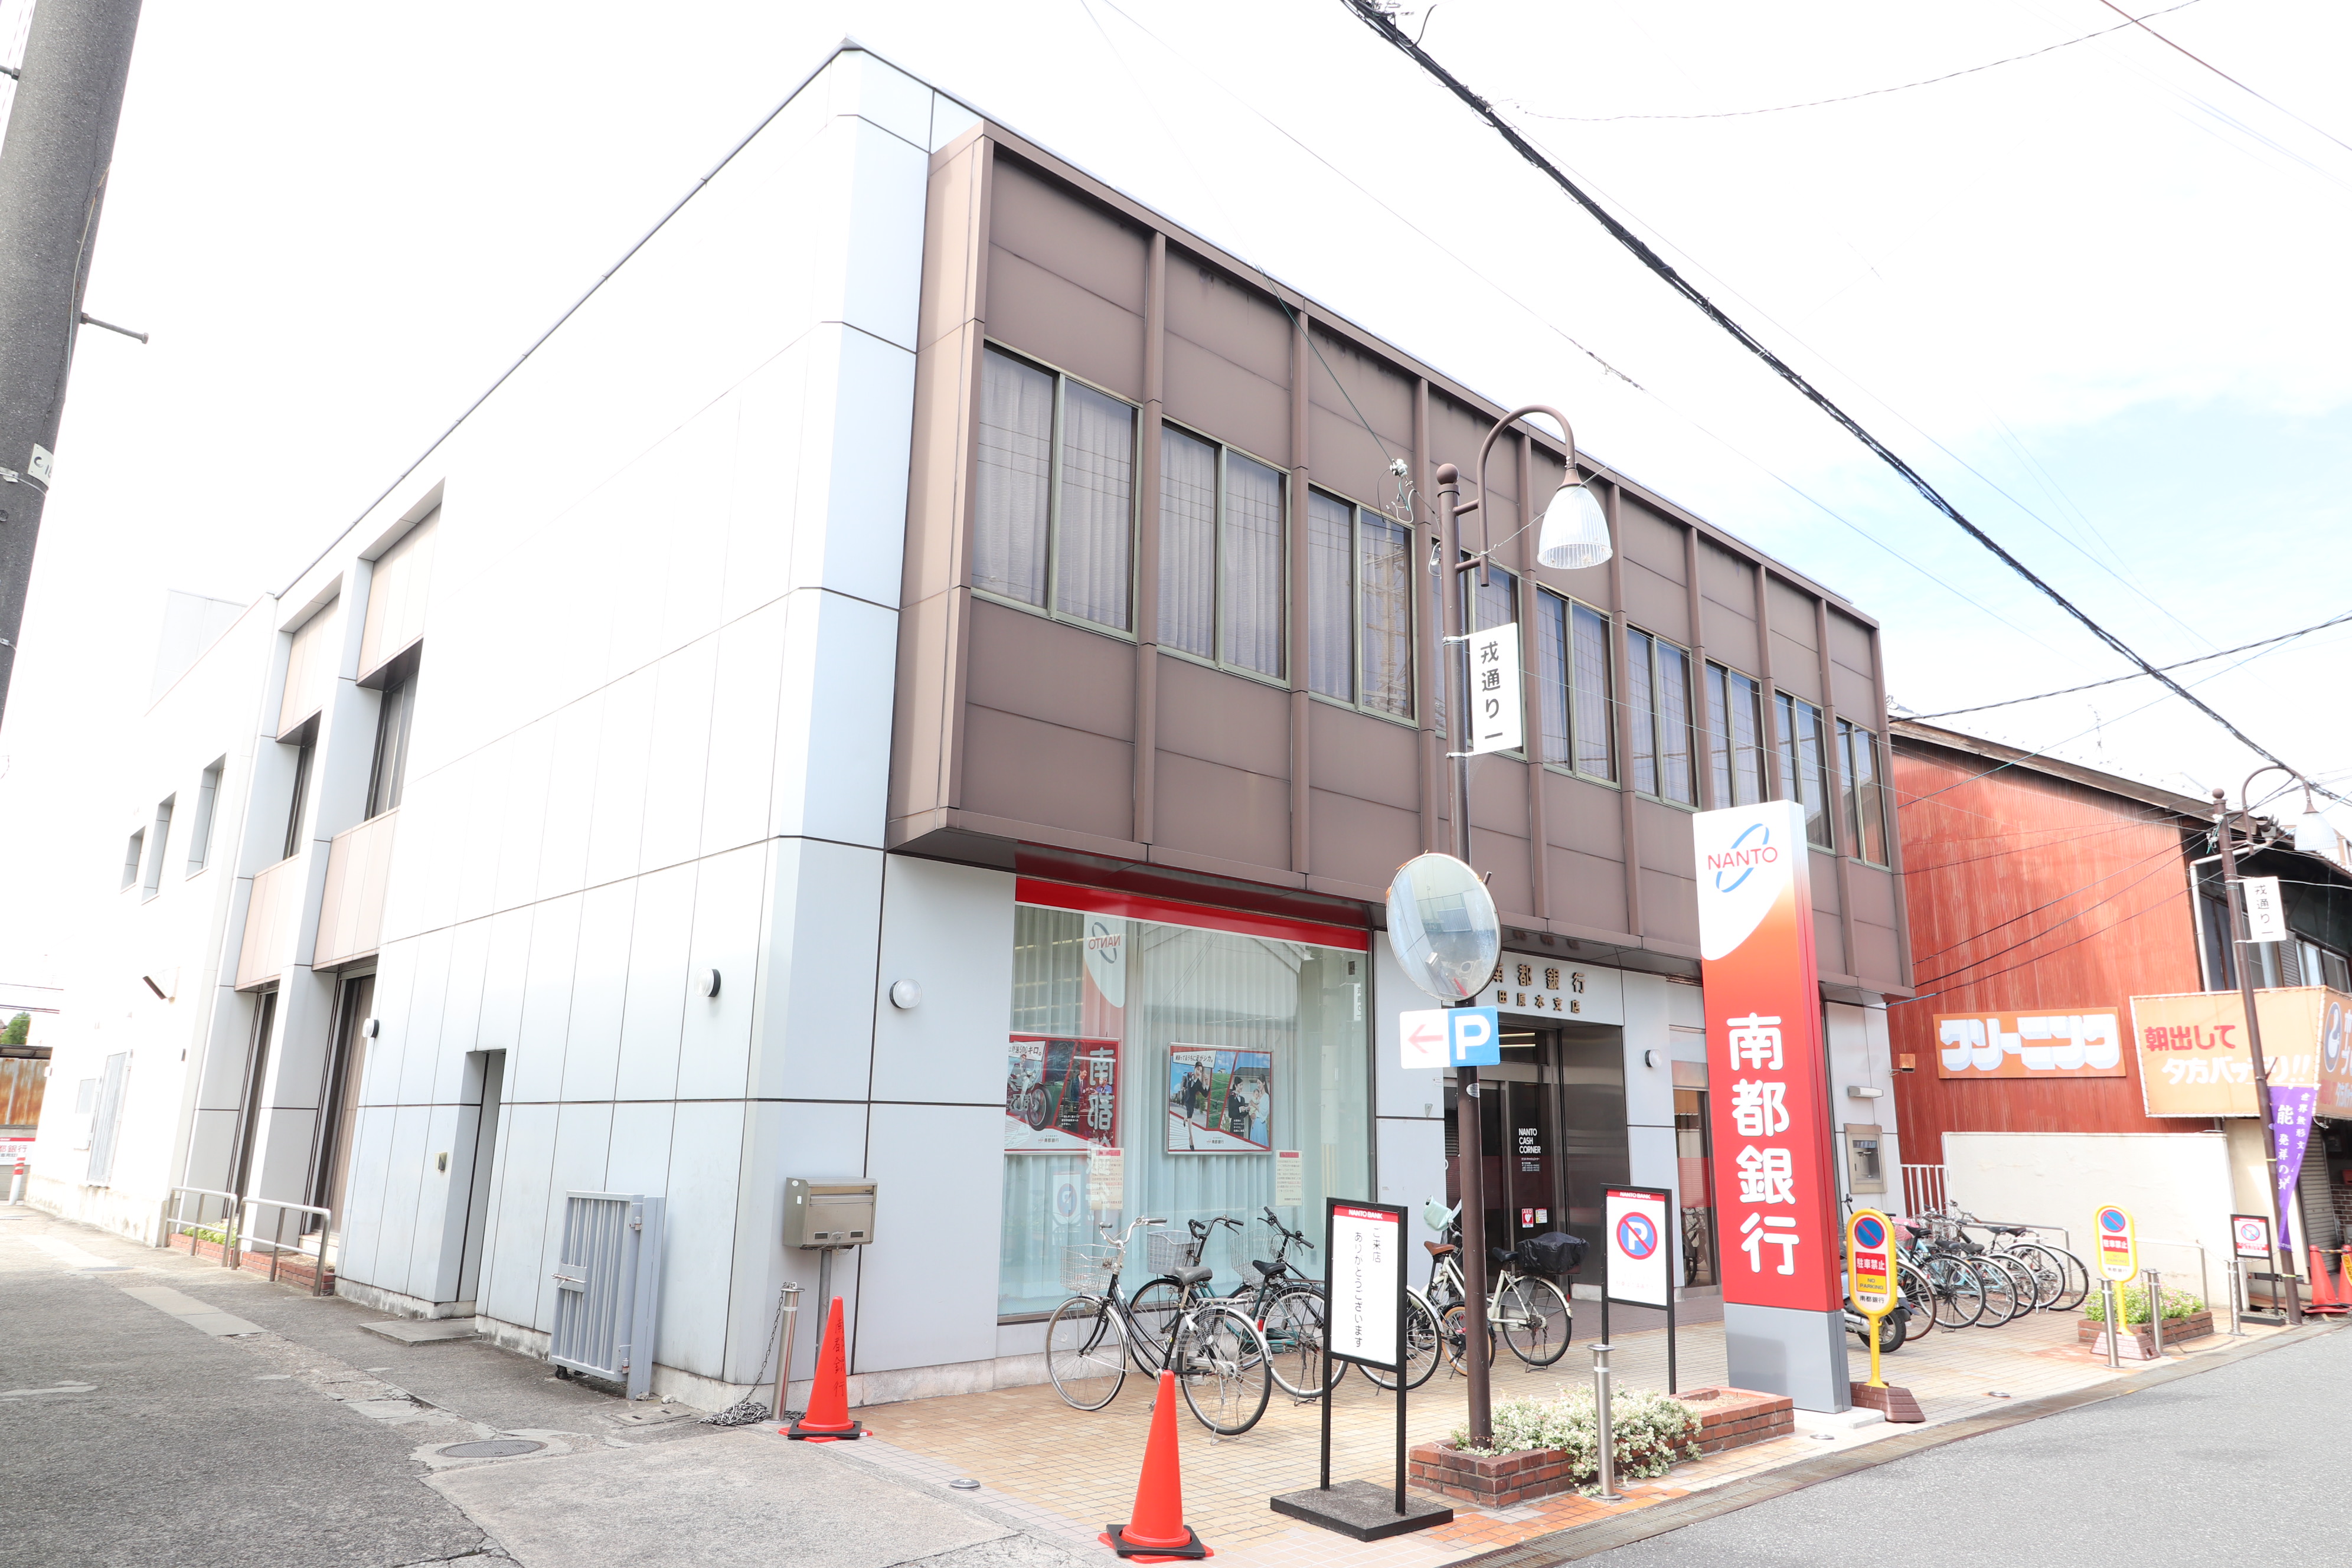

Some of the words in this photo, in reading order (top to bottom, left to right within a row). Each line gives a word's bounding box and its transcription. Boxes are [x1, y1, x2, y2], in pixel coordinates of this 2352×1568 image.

[1707, 846, 1778, 871] NANTO
[1497, 990, 1581, 1014] 田原本支店
[1455, 1015, 1491, 1060] P
[2144, 1025, 2236, 1051] 朝出して
[2277, 1104, 2294, 1125] 能
[1726, 1012, 1801, 1276] 南都銀行
[1348, 1209, 1367, 1217] NANTO
[1373, 1227, 1381, 1263] ご来店
[1857, 1257, 1885, 1270] 駐車禁止
[1354, 1232, 1363, 1347] ありがとうございます
[1860, 1282, 1884, 1291] PARKING
[1860, 1295, 1884, 1304] 南都銀行
